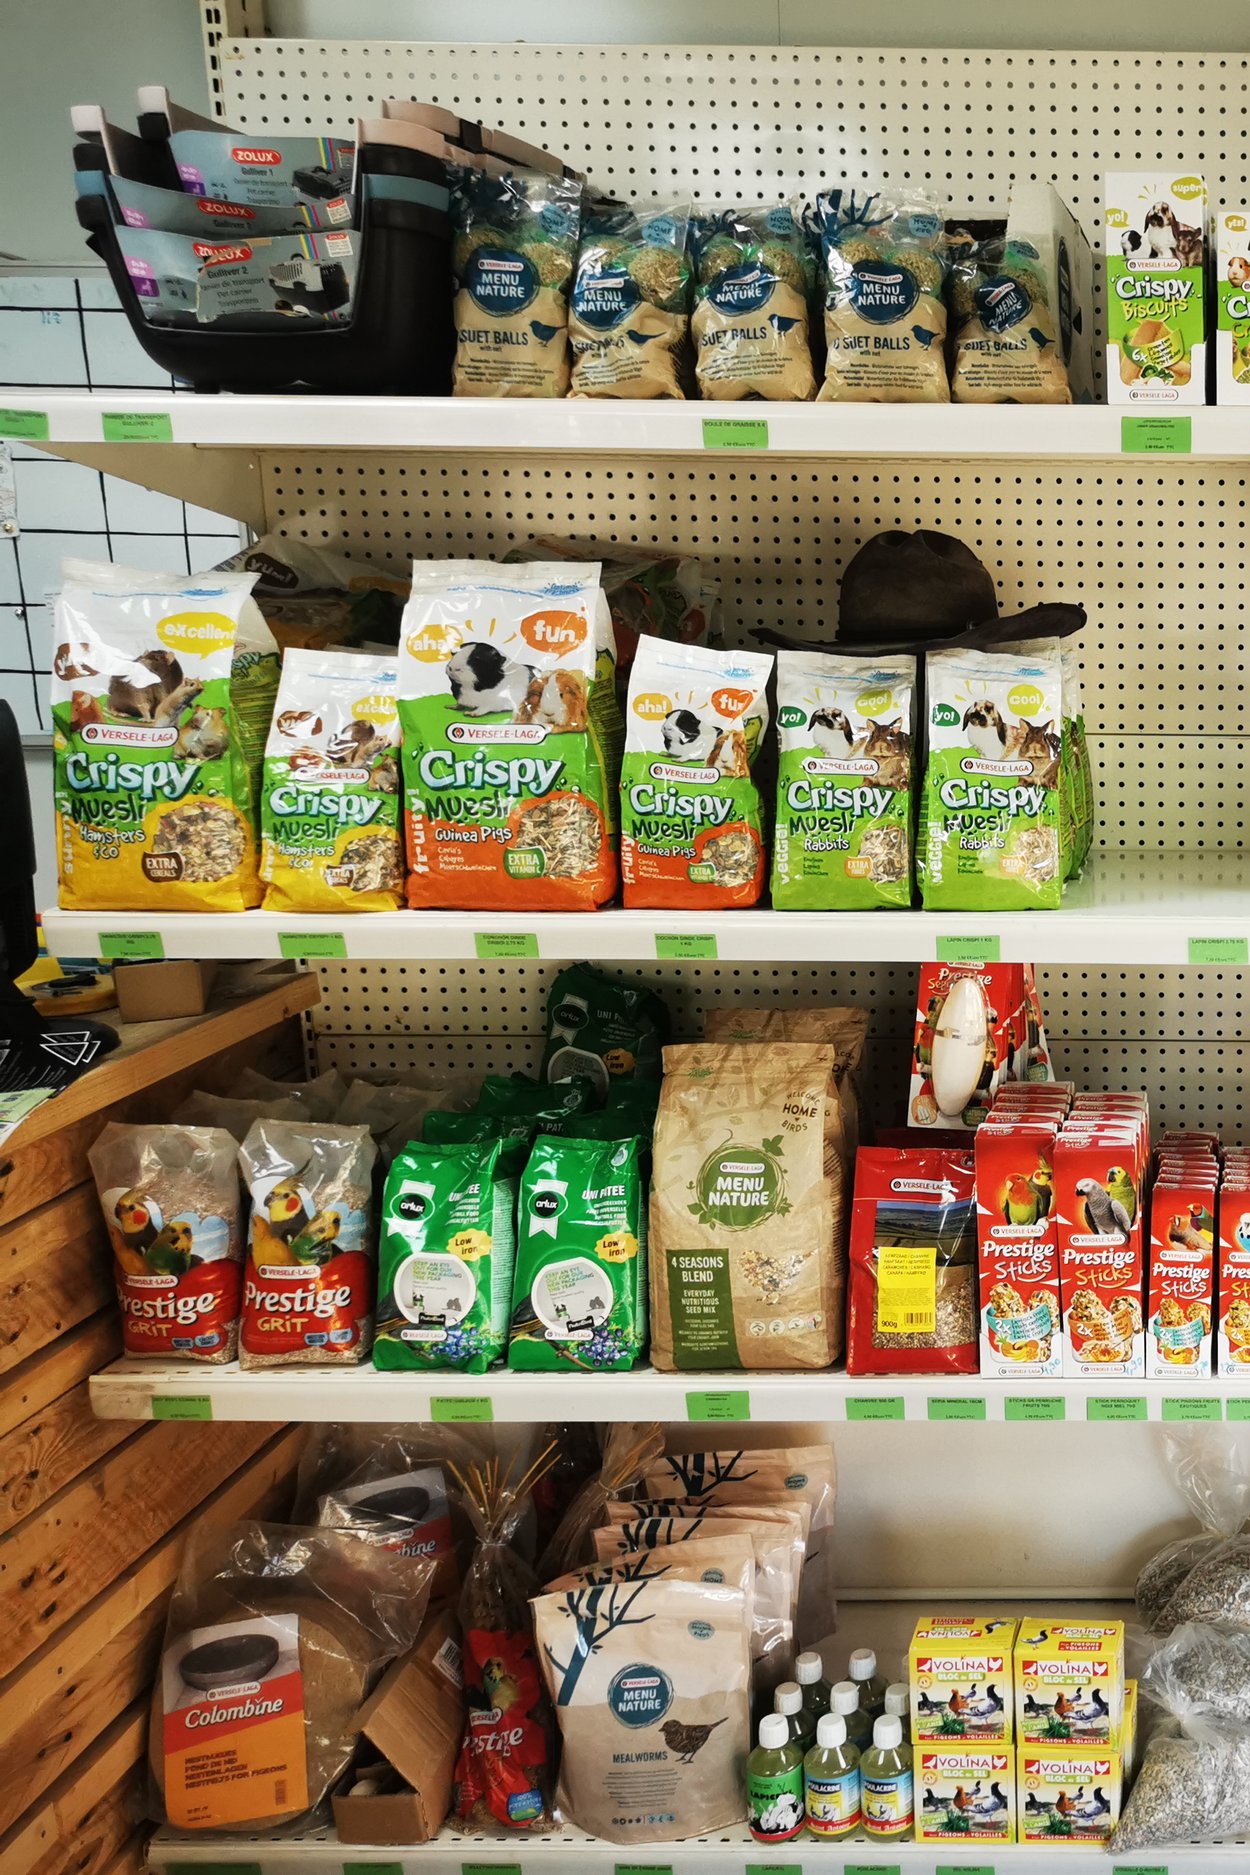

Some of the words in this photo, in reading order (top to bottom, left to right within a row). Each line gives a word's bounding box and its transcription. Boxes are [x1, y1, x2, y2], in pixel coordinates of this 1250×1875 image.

[236, 151, 276, 163] ZOLUX
[1172, 184, 1202, 195] super
[206, 203, 250, 217] ZOLUX
[1107, 211, 1125, 224] yo!
[1136, 260, 1179, 270] VERSELE-LAGA
[481, 272, 519, 286] MENU
[476, 283, 525, 298] NATURE
[584, 289, 622, 303] MENU
[715, 287, 763, 302] NATURE
[862, 283, 900, 296] MENU
[1115, 275, 1193, 304] Crispy
[578, 300, 627, 313] NATURE
[857, 293, 906, 306] NATURE
[1120, 295, 1189, 321] Biscuits
[460, 329, 492, 344] SUET
[494, 329, 529, 345] BALLS
[842, 335, 871, 350] SUET
[874, 336, 910, 351] BALLS
[636, 700, 668, 716] aha!
[780, 712, 801, 726] yo!
[933, 711, 955, 725] yo!
[101, 728, 175, 743] VERSELE-LAGA
[467, 728, 543, 741] VERSELE-LAGA
[419, 750, 563, 798] Crispy
[664, 768, 717, 780] VERSELE-LAGA
[974, 760, 1030, 773] VERSELE-LAGA
[65, 752, 201, 799] Crispy
[269, 784, 385, 827] Crispy
[425, 790, 516, 823] Muesli
[630, 784, 733, 825] Crispy
[787, 780, 895, 819] Crispy
[939, 780, 1048, 818] Crispy
[70, 794, 147, 825] Muesli
[632, 818, 697, 842] Muesli
[788, 812, 857, 837] Muesli
[79, 824, 147, 843] Hamsters
[434, 828, 479, 843] Guinea
[480, 826, 514, 846] Pigs
[278, 842, 336, 858] Hamsters
[804, 835, 851, 852] Rabbits
[959, 835, 1006, 851] Rabbits
[637, 842, 672, 856] Guinea
[672, 844, 697, 860] Pigs
[145, 857, 178, 872] EXTRA
[508, 854, 540, 868] EXTRA
[508, 866, 535, 875] VITAMIN
[536, 866, 542, 875] C
[783, 1103, 818, 1118] HOME
[780, 1119, 808, 1134] BIRDS
[716, 1176, 764, 1192] MENU
[535, 1200, 559, 1212] orlux
[708, 1190, 769, 1207] NATURE
[399, 1199, 426, 1214] orlux
[602, 1240, 620, 1252] Low
[609, 1247, 626, 1258] iron
[982, 1239, 1055, 1264] Prestige
[671, 1257, 677, 1269] 4
[678, 1256, 724, 1269] SEASONS
[1063, 1248, 1136, 1272] Prestige
[682, 1270, 714, 1283] BLEND
[993, 1259, 1053, 1283] Sticks
[1074, 1265, 1133, 1289] Sticks
[1152, 1263, 1211, 1284] Prestige
[683, 1289, 715, 1298] EVERYDAY
[1161, 1279, 1207, 1299] Sticks
[244, 1280, 352, 1318] Prestige
[681, 1298, 720, 1306] NUTRITIOUS
[685, 1306, 702, 1315] SEED
[703, 1306, 717, 1315] MIX
[881, 1319, 898, 1330] 900g
[995, 1319, 1012, 1335] 2x
[932, 1659, 986, 1672] VOLINA
[1038, 1663, 1091, 1676] VOLINA
[938, 1672, 959, 1681] BLOC
[968, 1672, 984, 1681] SEL
[624, 1689, 657, 1701] MENU
[618, 1698, 661, 1712] NATURE
[184, 1696, 284, 1730] Colombine
[612, 1750, 669, 1765] MEALWORMS
[938, 1757, 990, 1769] VOLINA
[1041, 1762, 1093, 1774] VOLINA
